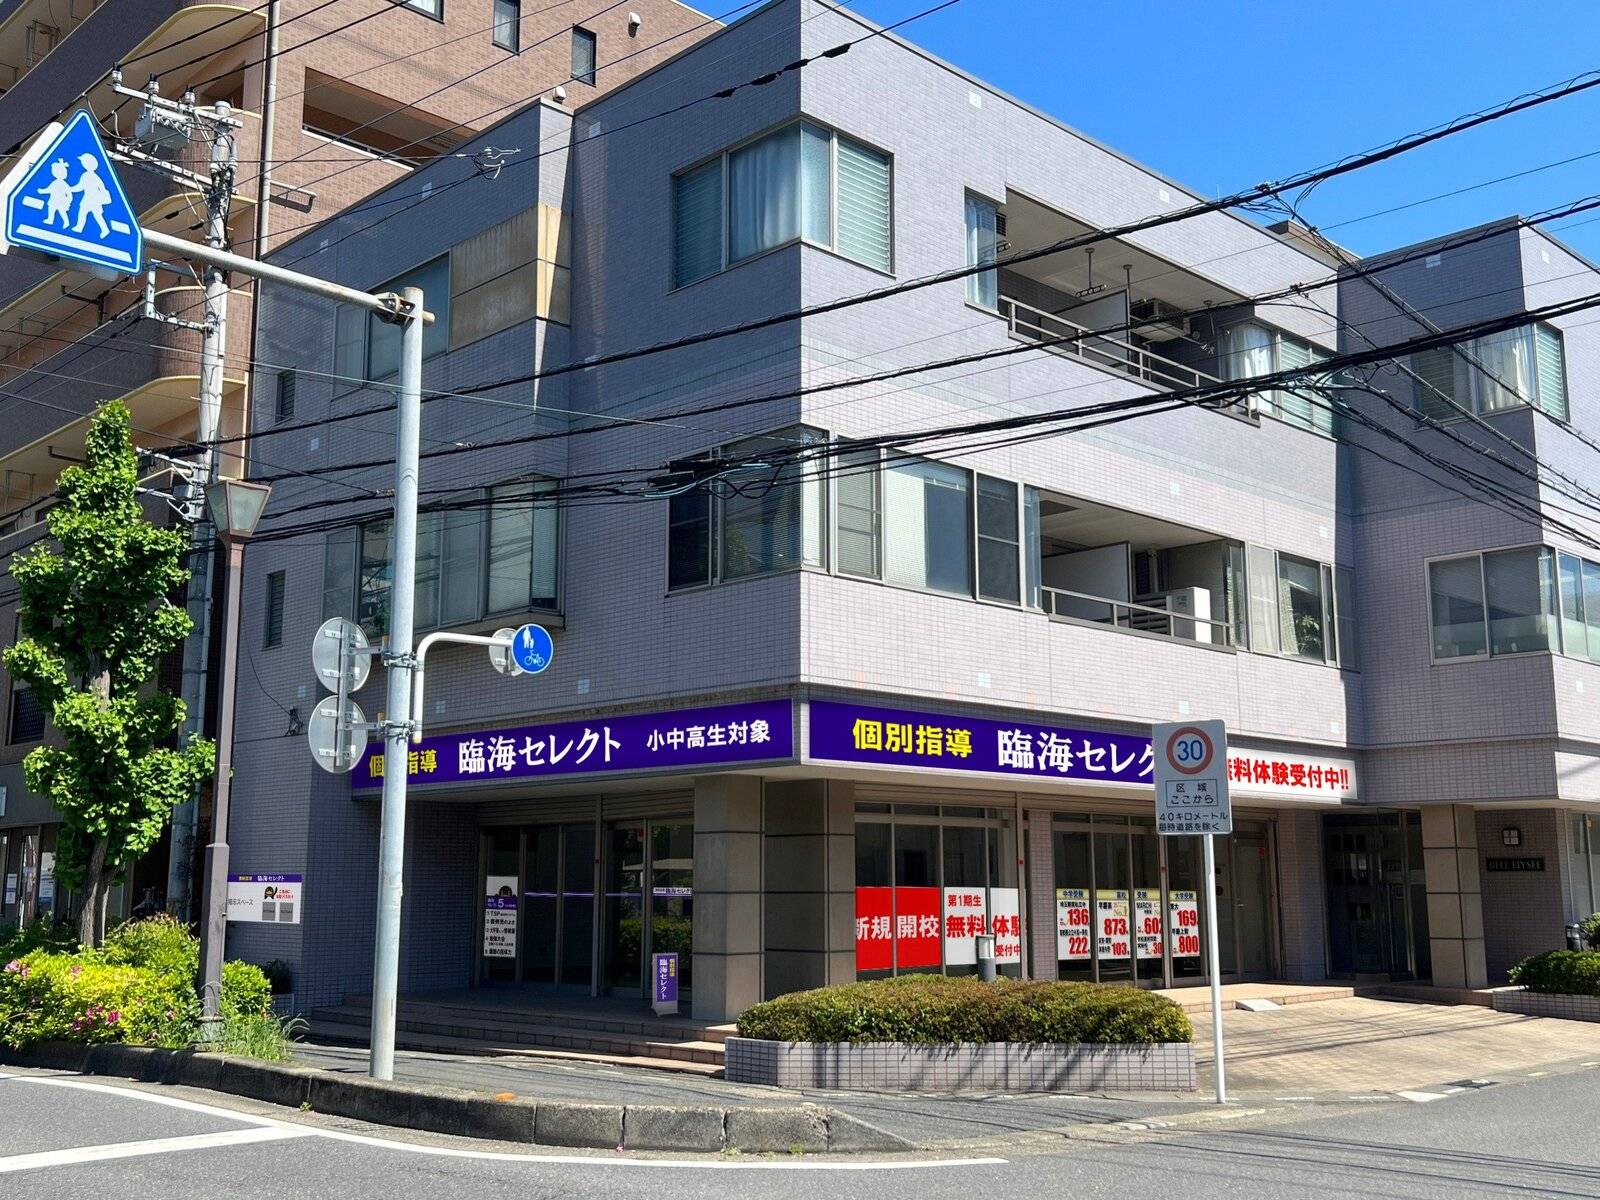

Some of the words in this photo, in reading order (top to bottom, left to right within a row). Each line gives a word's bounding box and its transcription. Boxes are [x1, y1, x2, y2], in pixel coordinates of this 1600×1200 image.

[852, 718, 973, 759] 個別指導
[369, 749, 437, 778] 個指導
[458, 726, 622, 775] 臨海セレクト
[646, 719, 771, 753] 小中高生対象
[1177, 739, 1203, 761] 30
[1170, 794, 1214, 805] ここから
[1159, 812, 1229, 821] 40キロメートル
[948, 894, 982, 907] 第1期生
[1068, 908, 1088, 926] 136
[1177, 910, 1197, 927] 169
[856, 914, 940, 941] 新規開校
[1104, 918, 1126, 936] 873
[1068, 937, 1088, 954] 222
[1112, 942, 1127, 956] 103
[1178, 936, 1198, 954] 800
